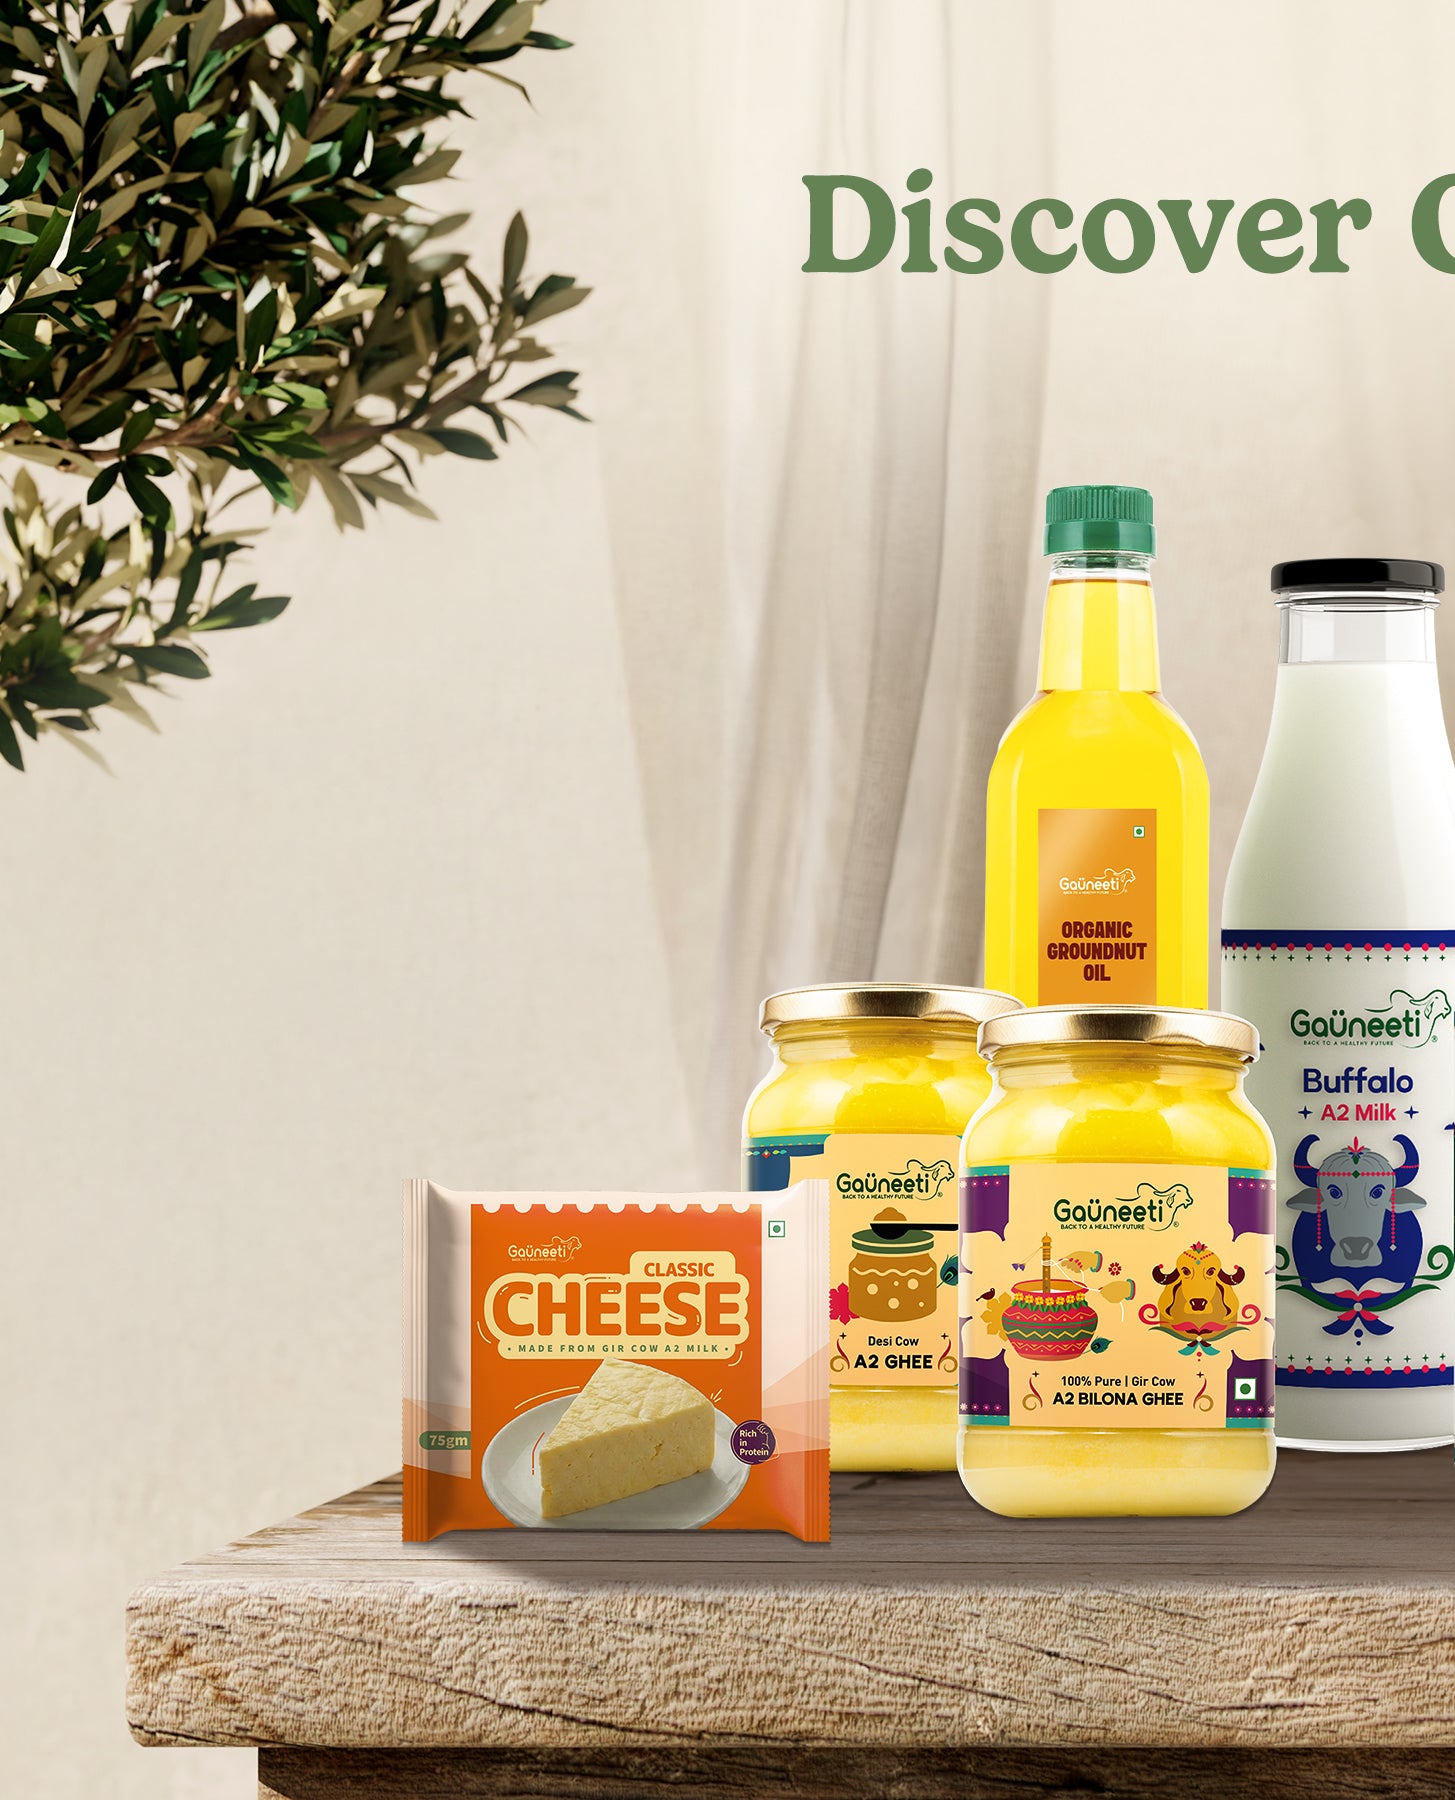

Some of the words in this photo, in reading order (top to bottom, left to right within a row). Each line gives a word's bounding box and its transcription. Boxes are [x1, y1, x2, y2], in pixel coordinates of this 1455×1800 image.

[1061, 921, 1133, 938] ORGANIC
[1047, 942, 1147, 960] GROUNDNUT
[1083, 964, 1111, 981] OIL
[1290, 1009, 1420, 1037] Gaüneeti
[1303, 1066, 1413, 1094] Buffalo
[1321, 1103, 1349, 1121] A2
[1355, 1102, 1396, 1121] Milk
[836, 1172, 929, 1193] Gaüneeti
[1054, 1199, 1163, 1222] Gaüneeti
[643, 1262, 715, 1277] CLASSIC
[492, 1281, 741, 1337] CHEESE
[518, 1344, 554, 1353] MADE
[560, 1344, 596, 1353] FROM
[602, 1344, 625, 1353] GIR
[631, 1344, 659, 1353] COW
[664, 1344, 680, 1353] A2
[687, 1344, 719, 1353] MILK
[868, 1336, 893, 1347] Desi
[895, 1336, 919, 1347] Cow
[854, 1354, 879, 1369] A2
[884, 1354, 933, 1369] GHEE
[1061, 1376, 1092, 1386] 100%
[1094, 1376, 1122, 1386] Pure
[1132, 1376, 1149, 1386] Gir
[1151, 1376, 1175, 1387] Cow
[1053, 1392, 1075, 1406] A2
[1078, 1392, 1138, 1406] BILONA
[1142, 1392, 1184, 1406] GHEE
[429, 1435, 468, 1449] 75gm
[739, 1430, 757, 1438] Rich
[739, 1448, 769, 1456] Protein
